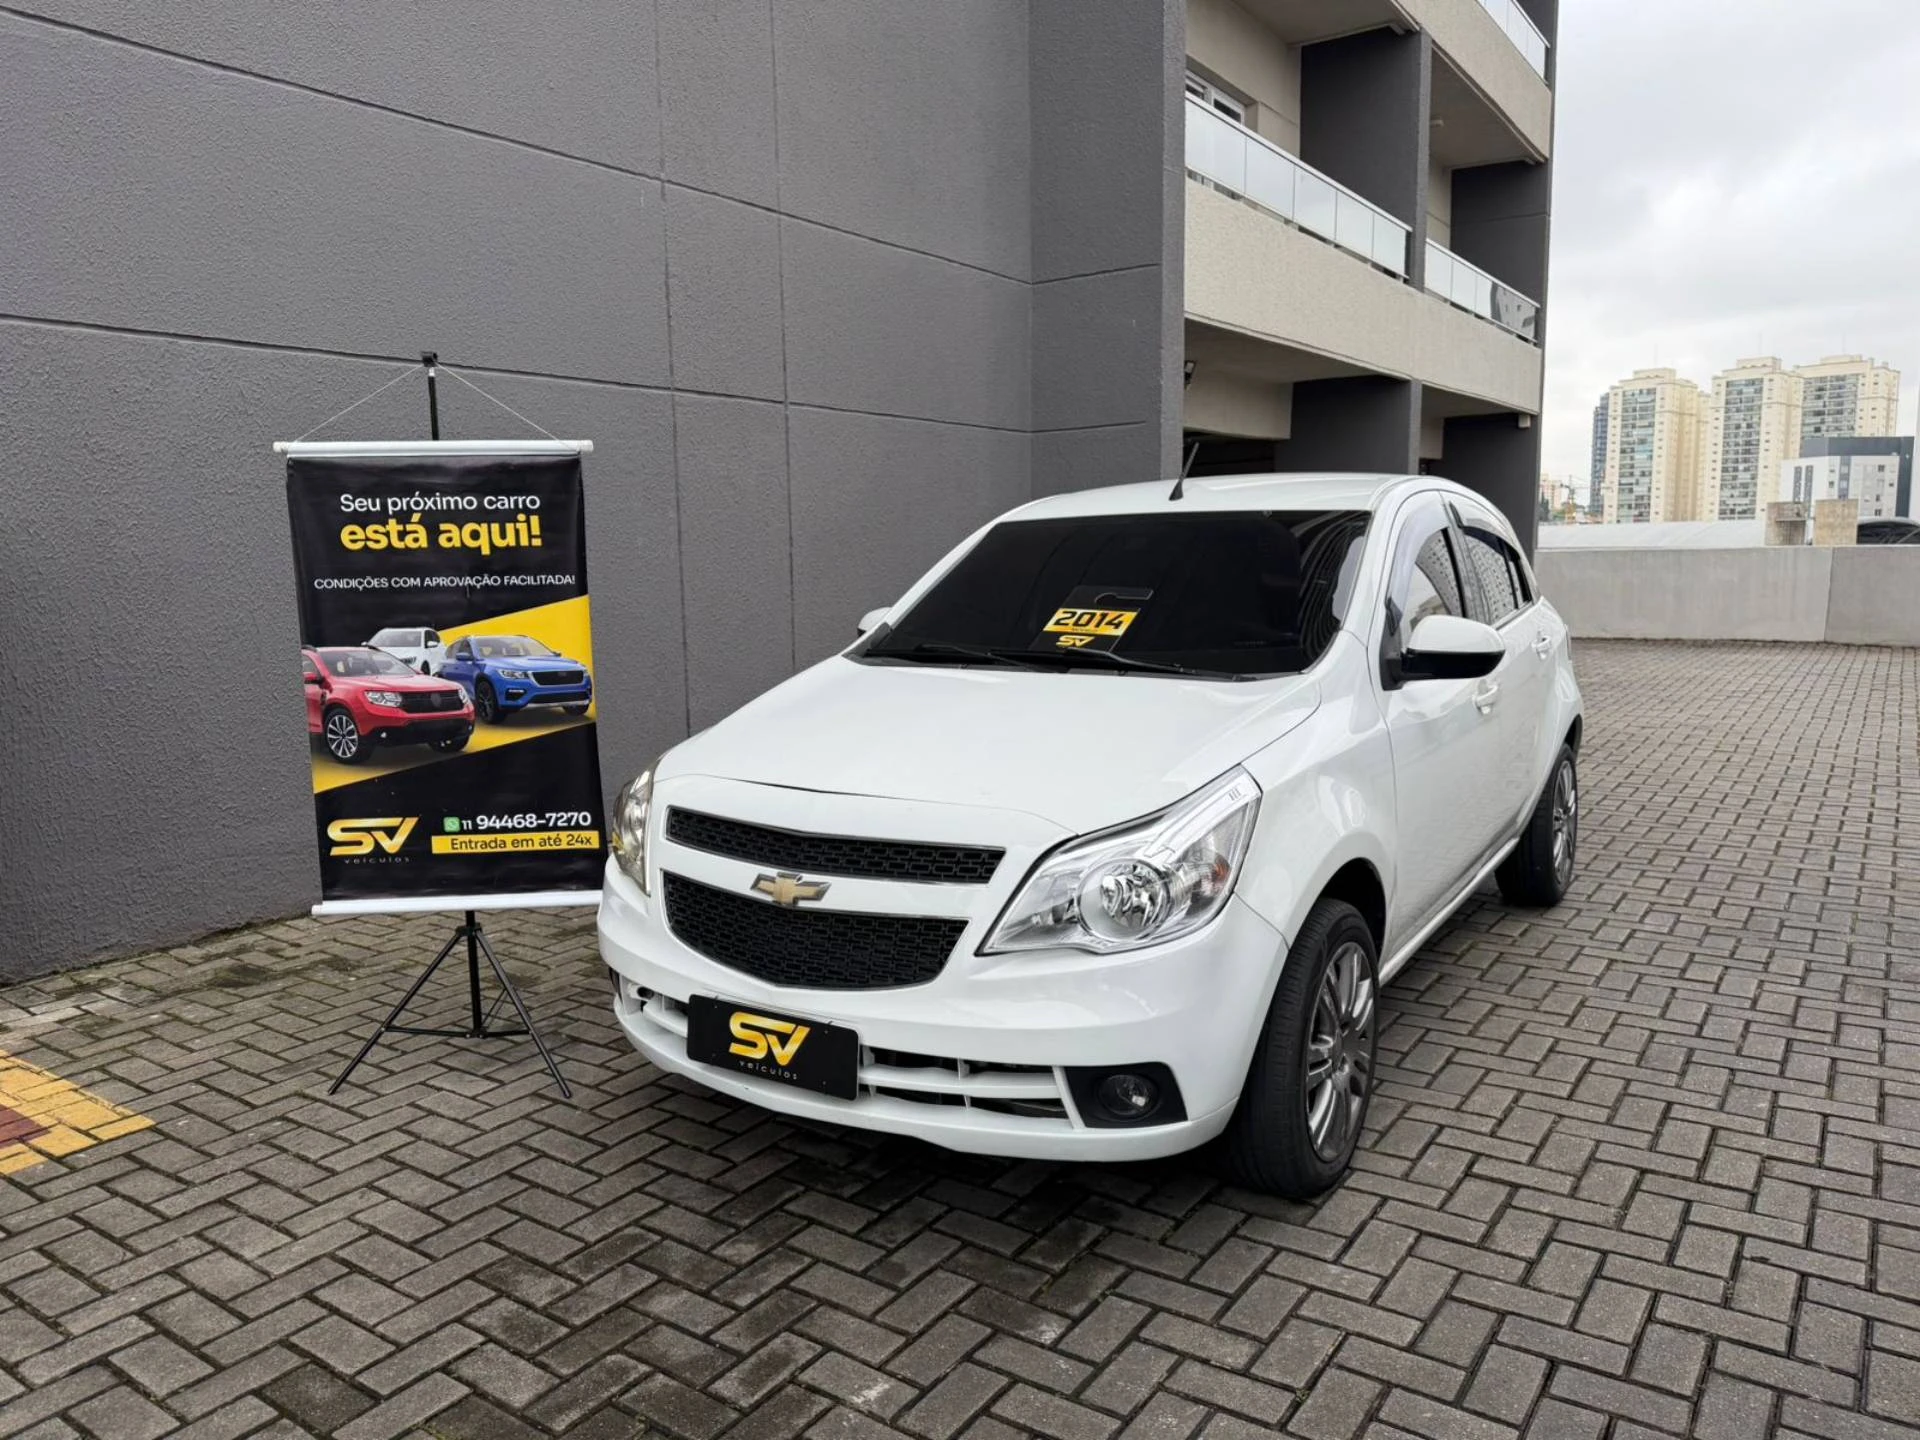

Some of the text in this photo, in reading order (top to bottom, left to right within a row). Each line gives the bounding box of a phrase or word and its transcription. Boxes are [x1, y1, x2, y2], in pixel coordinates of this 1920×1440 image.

[340, 491, 540, 515] Seu próximo carro
[340, 513, 543, 555] está aqui!
[314, 573, 575, 591] CONDIÇÕES COM APROVAÇÃO FACILITADA!
[1053, 611, 1126, 629] 2014
[1055, 634, 1095, 647] SV
[461, 811, 591, 830] 11 94468-7270
[326, 817, 420, 856] SV
[450, 833, 593, 851] Entrada em até 24x
[728, 1011, 811, 1067] SV
